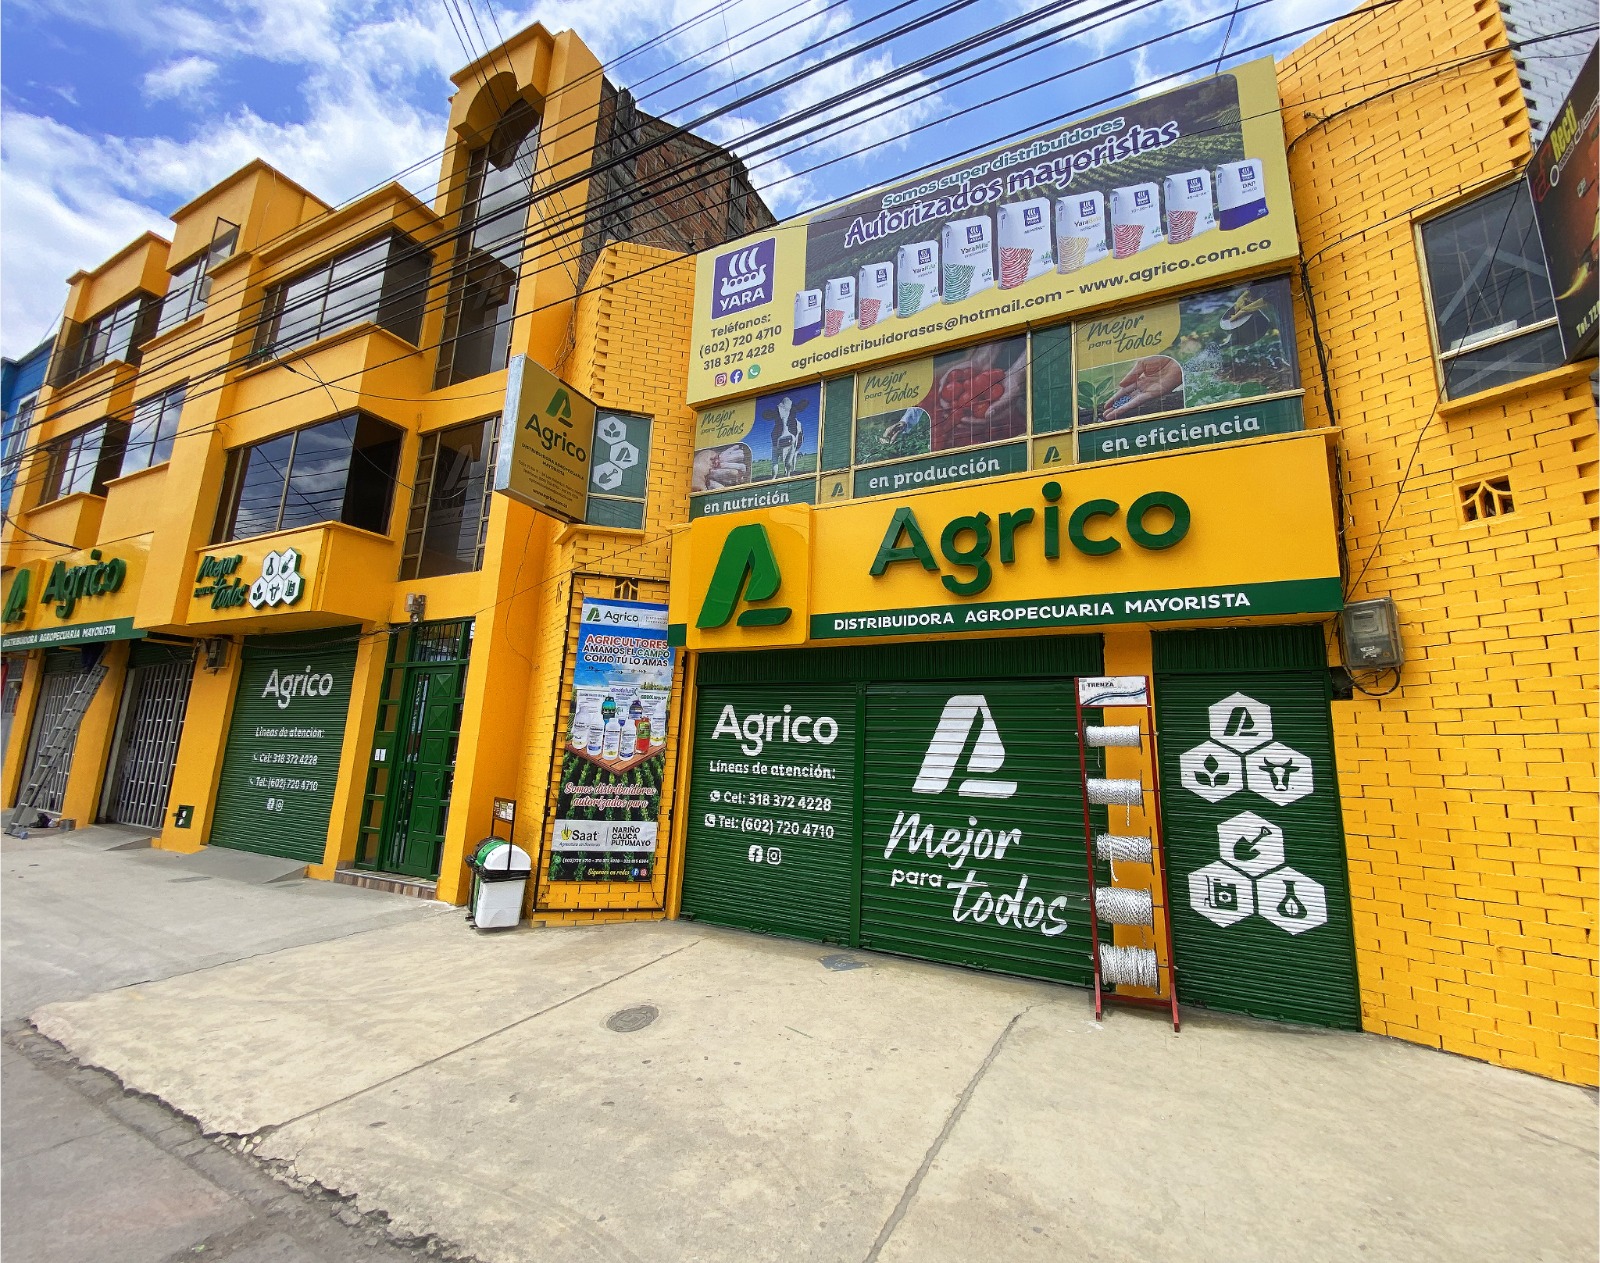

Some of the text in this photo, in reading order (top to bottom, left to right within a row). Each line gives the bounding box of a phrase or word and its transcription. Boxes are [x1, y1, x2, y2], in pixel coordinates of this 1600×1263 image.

[882, 116, 1125, 210] Somos super distribuidores
[844, 120, 1179, 249] Autorizados mayoristas
[719, 287, 766, 312] YARA
[791, 289, 1062, 370] agricodistribuidorasas@hotmail.com
[1078, 238, 1273, 295] www.agrico.com.co
[711, 313, 771, 338] Teléfonos:
[1086, 313, 1163, 353] Mejor para todos
[699, 325, 782, 359] (602) 720 4710
[703, 343, 775, 371] 318 372 4228
[864, 370, 920, 405] Mejor para todos
[700, 409, 736, 428] Mejor
[716, 420, 745, 439] todos
[525, 413, 587, 462] Agrico
[1102, 415, 1260, 454] en eficiencia
[869, 457, 1000, 490] en producción
[703, 491, 789, 514] en nutrición
[869, 481, 1192, 597] Agrico
[195, 554, 243, 586] Mejor
[41, 549, 127, 620] Agrico
[211, 577, 250, 610] todos
[604, 611, 639, 623] Agrico
[832, 591, 1252, 631] DISTRIBUIDORA AGROPECUARIA MAYORISTA
[39, 629, 80, 642] AGROPECUARIA
[82, 624, 116, 637] MAYORISTA
[586, 634, 668, 649] AGRICULTORES
[583, 645, 670, 658] AMAMOS EL CAMPO
[584, 654, 668, 667] COMO TÚ LO AMAS
[261, 665, 334, 710] Agrico
[255, 726, 326, 739] Líneas de atención:
[711, 704, 839, 756] Agrico
[286, 754, 299, 764] 372
[299, 754, 318, 765] 4228
[709, 760, 836, 779] Líneas de atención:
[286, 779, 301, 790] 720
[564, 782, 657, 796] Somos distribuidores
[573, 795, 649, 811] autorizados para
[723, 790, 832, 811] Cel: 318 372 4228
[572, 829, 598, 841] Saat
[612, 825, 641, 834] NARIÑO
[718, 815, 835, 839] Tel: (602) 720 4710
[610, 839, 651, 847] PUTUMAYO
[884, 810, 1023, 870] Mejor
[890, 869, 1068, 937] para todos
